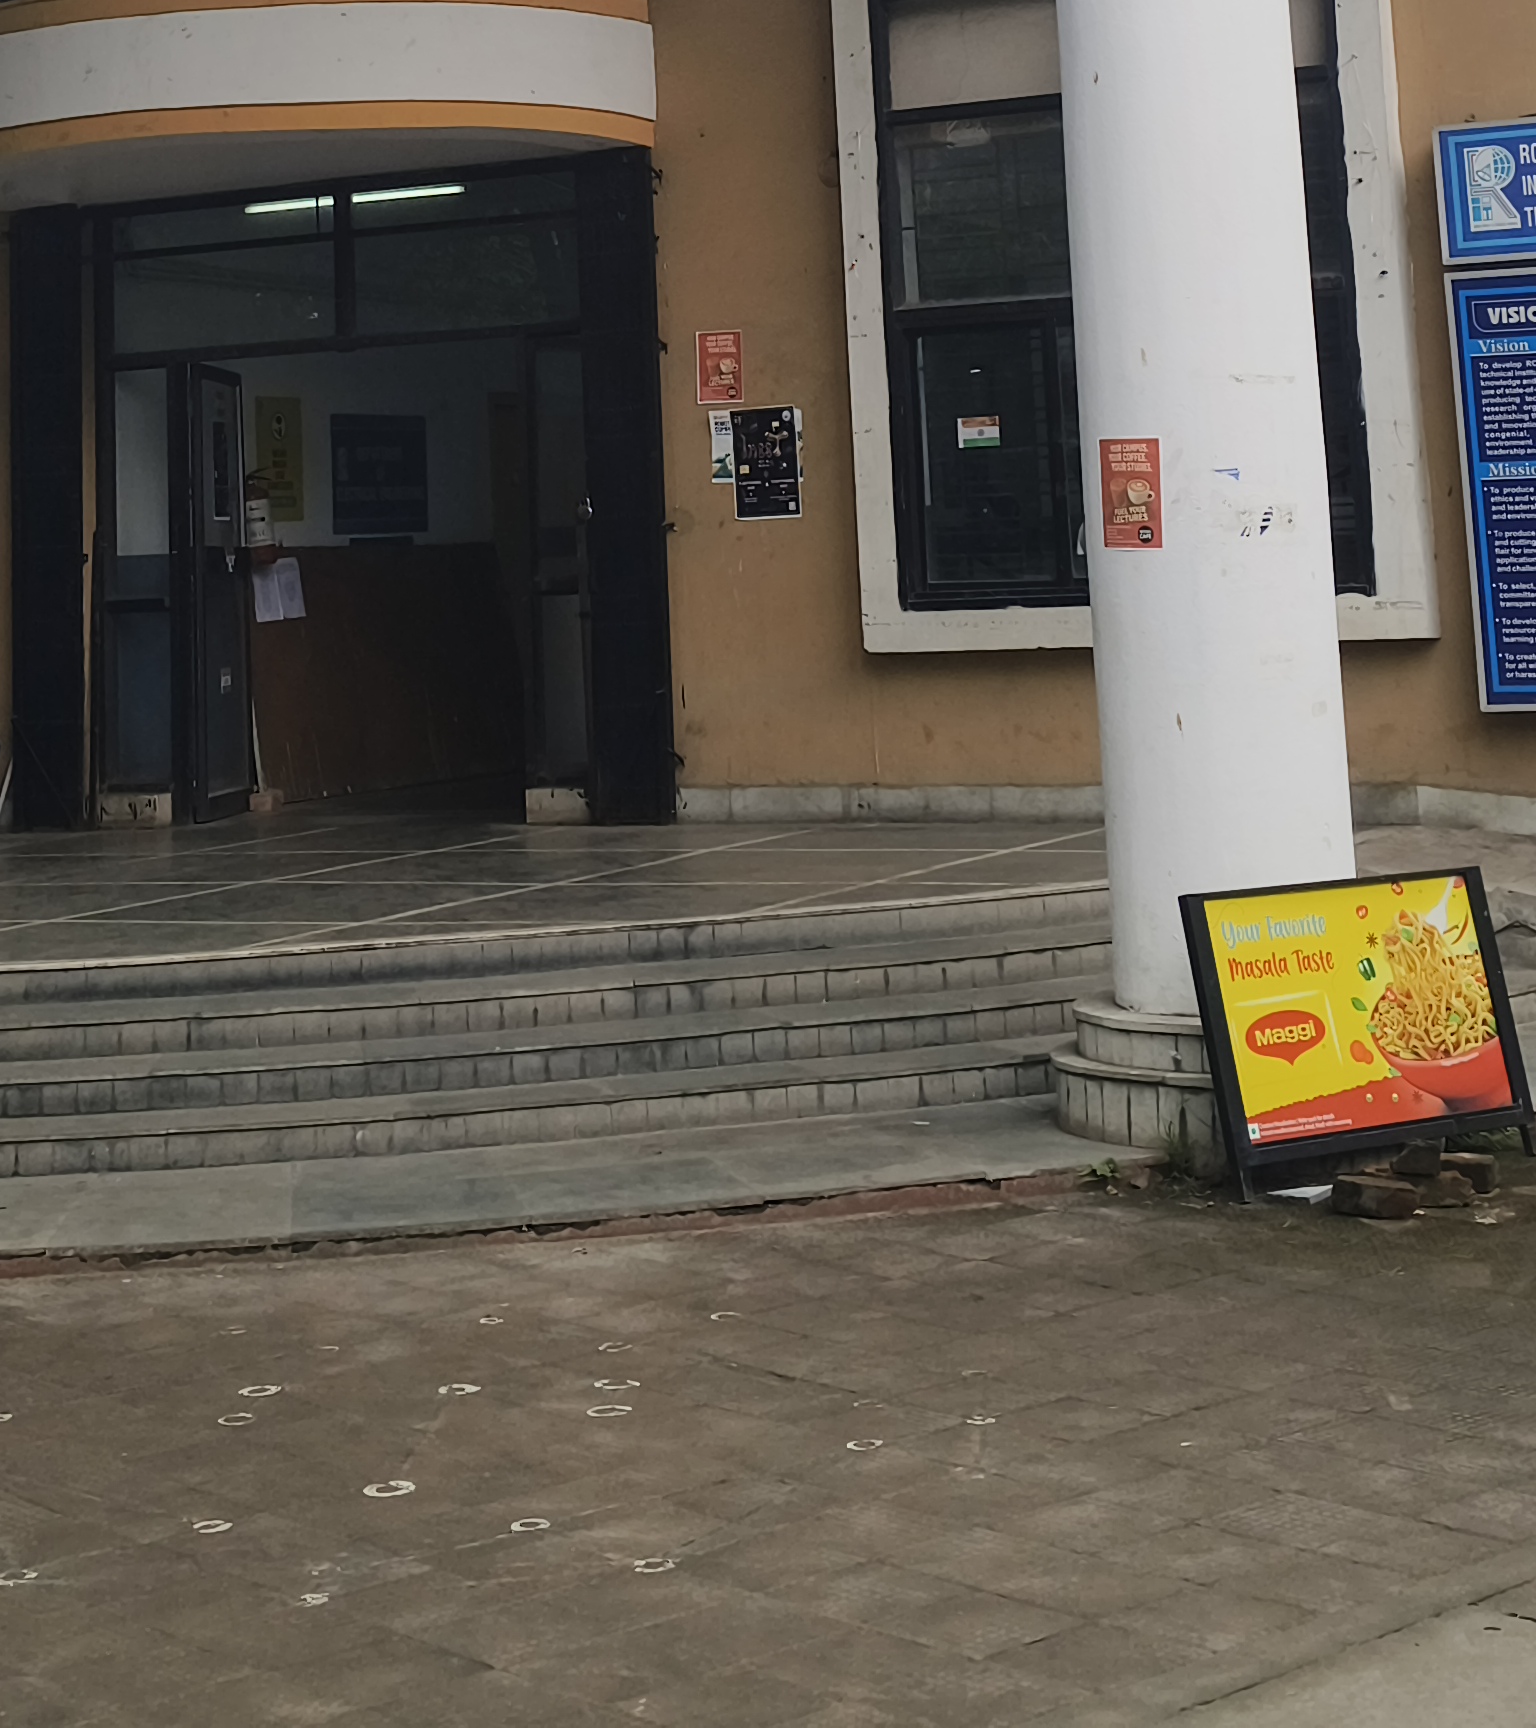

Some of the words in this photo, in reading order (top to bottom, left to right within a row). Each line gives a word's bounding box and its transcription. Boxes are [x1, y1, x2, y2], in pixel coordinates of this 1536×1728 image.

[1477, 338, 1530, 353] Vision
[1221, 920, 1261, 950] Your
[1265, 914, 1326, 941] Favorite
[1227, 951, 1291, 982] Masala
[1291, 949, 1335, 974] Taste
[1254, 1019, 1316, 1047] Maggi
